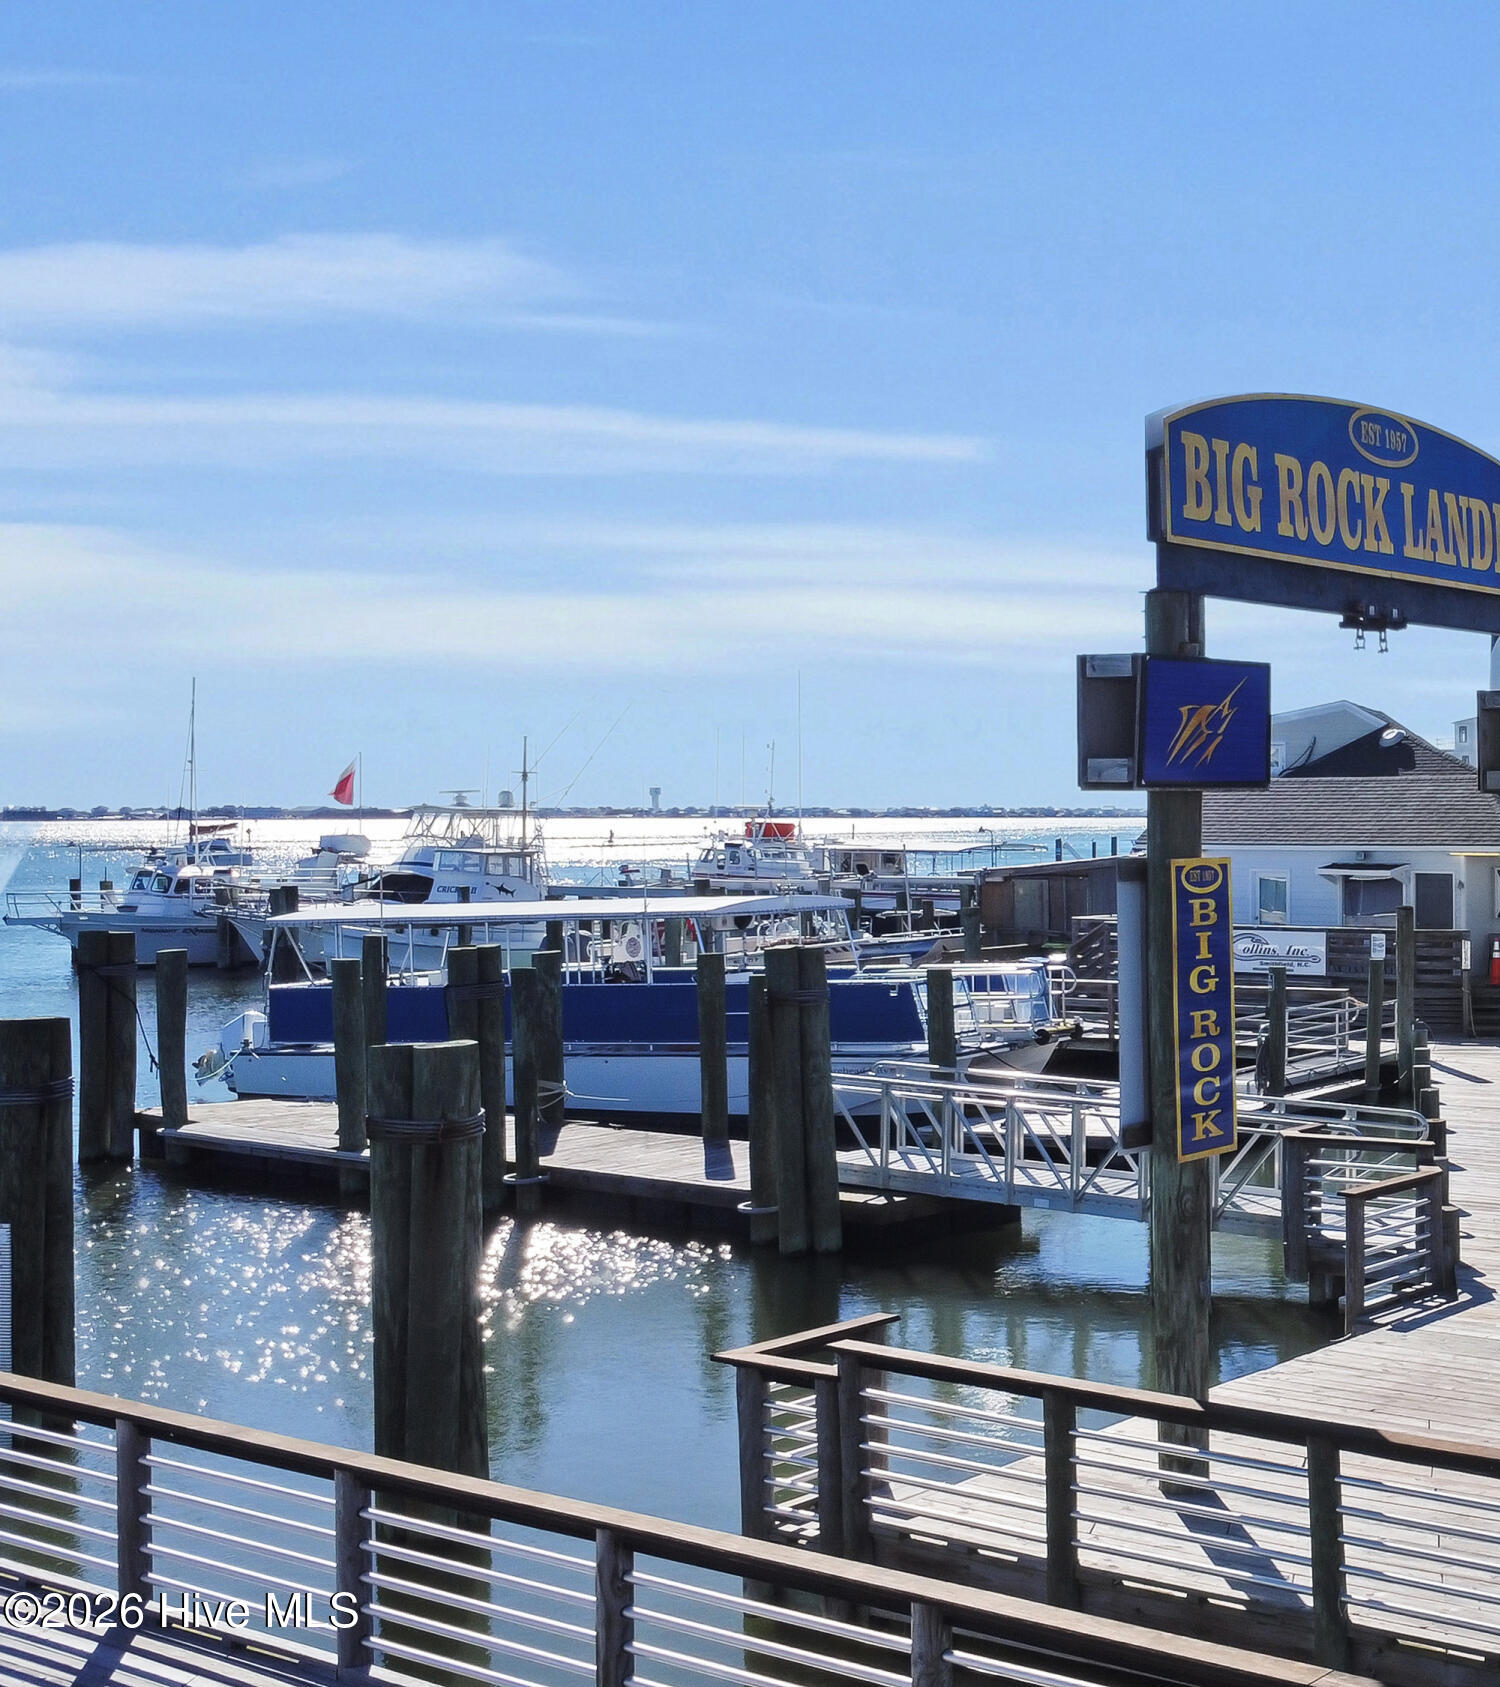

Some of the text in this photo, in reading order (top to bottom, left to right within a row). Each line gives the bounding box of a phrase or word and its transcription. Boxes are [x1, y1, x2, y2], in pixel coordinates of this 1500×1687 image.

[1361, 420, 1407, 453] EST 1957
[1181, 431, 1263, 534] BIG
[1274, 452, 1395, 556] ROCK
[1188, 898, 1220, 994] BIG
[1285, 945, 1310, 956] Inc.
[1189, 1009, 1224, 1141] ROCK
